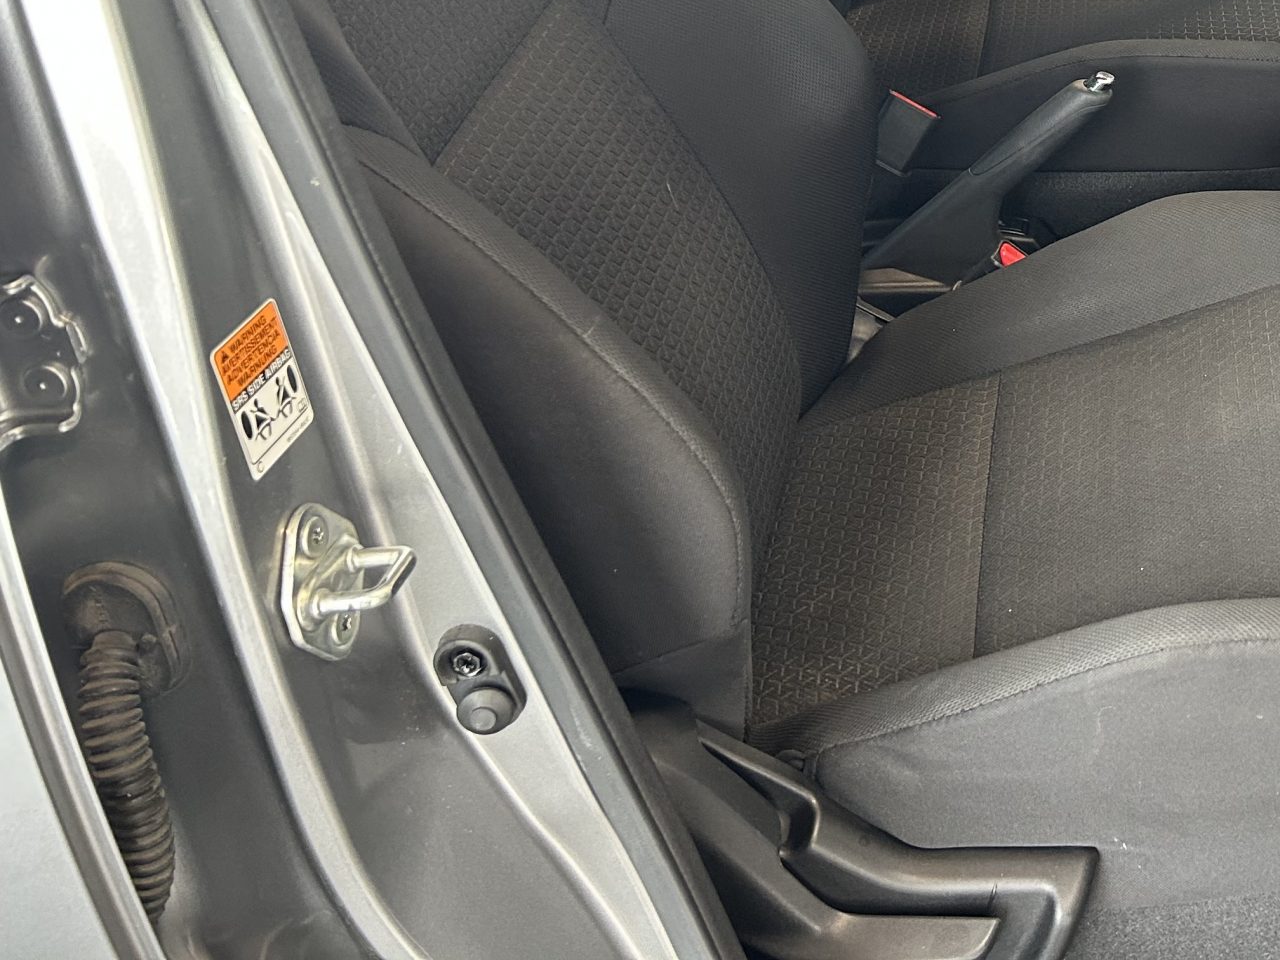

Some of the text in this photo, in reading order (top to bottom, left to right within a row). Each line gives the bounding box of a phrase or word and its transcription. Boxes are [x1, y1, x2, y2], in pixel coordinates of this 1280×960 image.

[222, 316, 278, 375] AVERTISSEMENT
[226, 329, 280, 386] ADVERTENCIA
[228, 315, 267, 354] WARNING
[231, 348, 292, 411] SRS SIDE AIRBAG
[237, 344, 278, 386] WARNUNG
